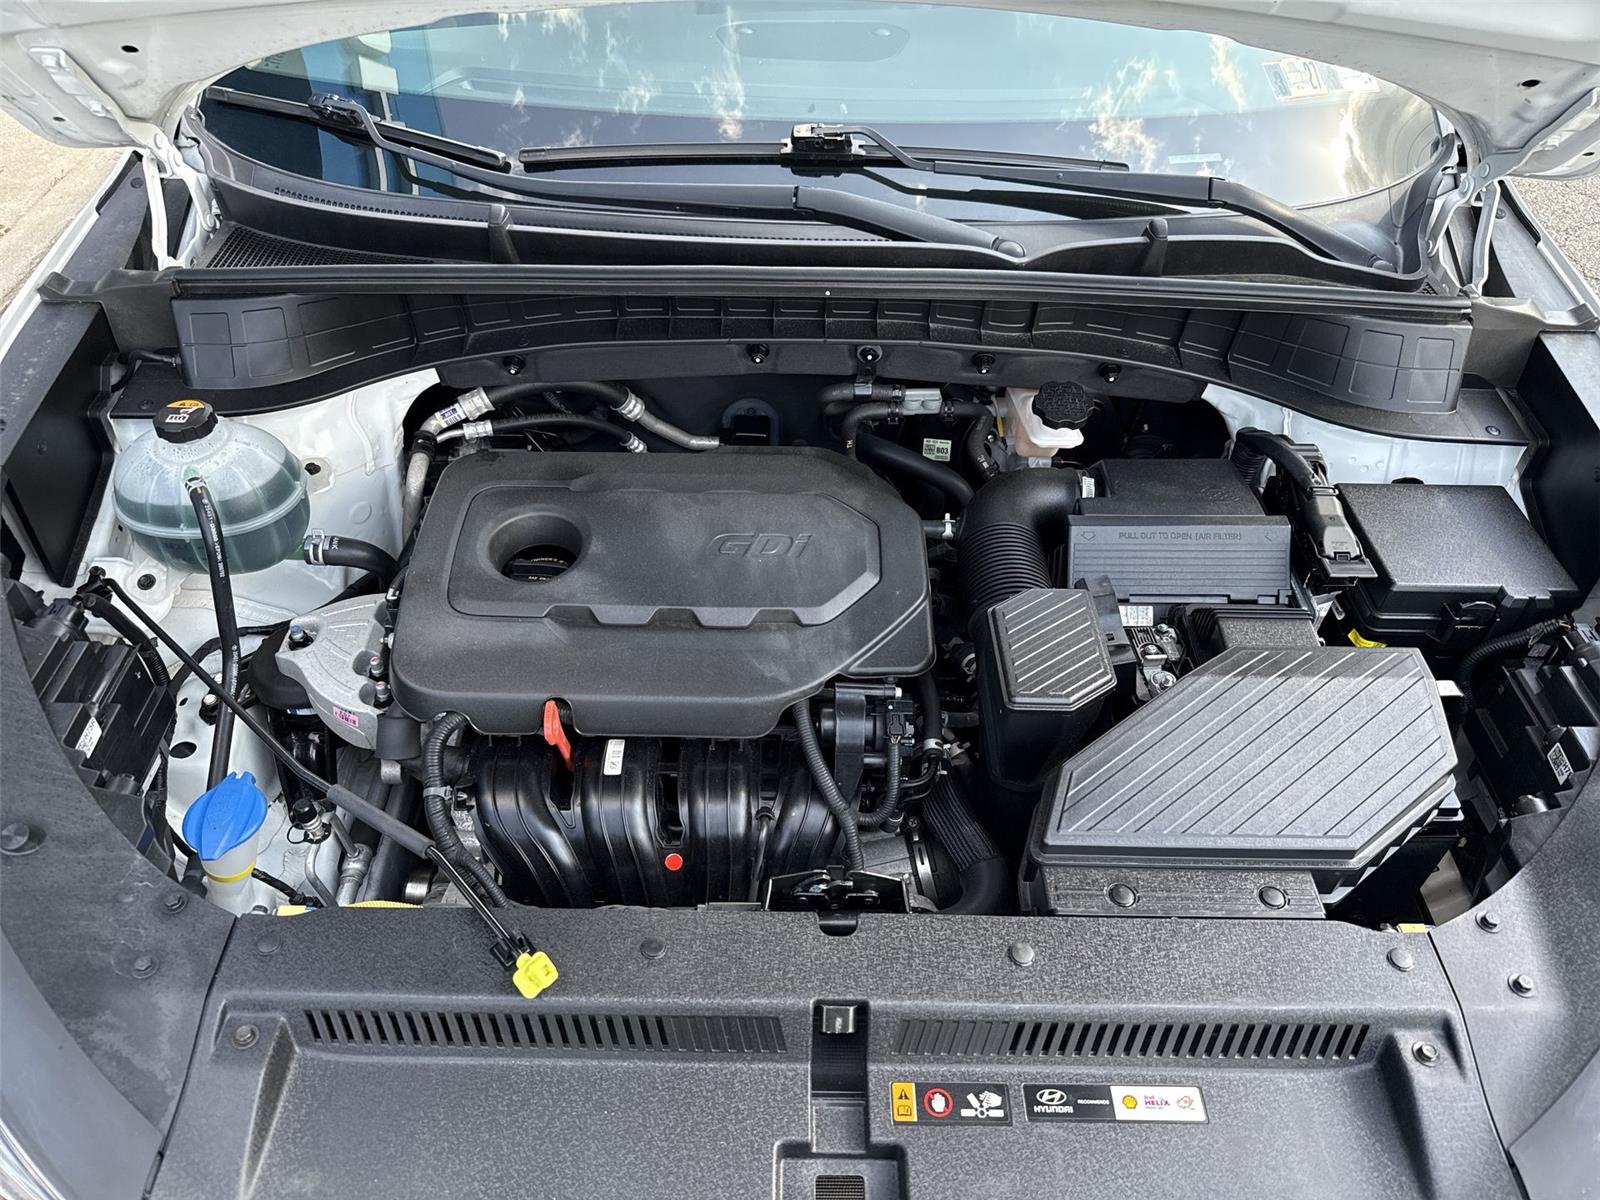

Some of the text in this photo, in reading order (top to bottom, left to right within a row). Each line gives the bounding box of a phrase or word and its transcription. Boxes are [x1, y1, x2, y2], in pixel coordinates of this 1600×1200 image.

[1119, 531, 1139, 539] PULL
[1140, 531, 1157, 539] OUT
[1158, 531, 1168, 539] TO
[1170, 531, 1192, 540] OPEN
[1033, 1105, 1074, 1114] HYUNDAI
